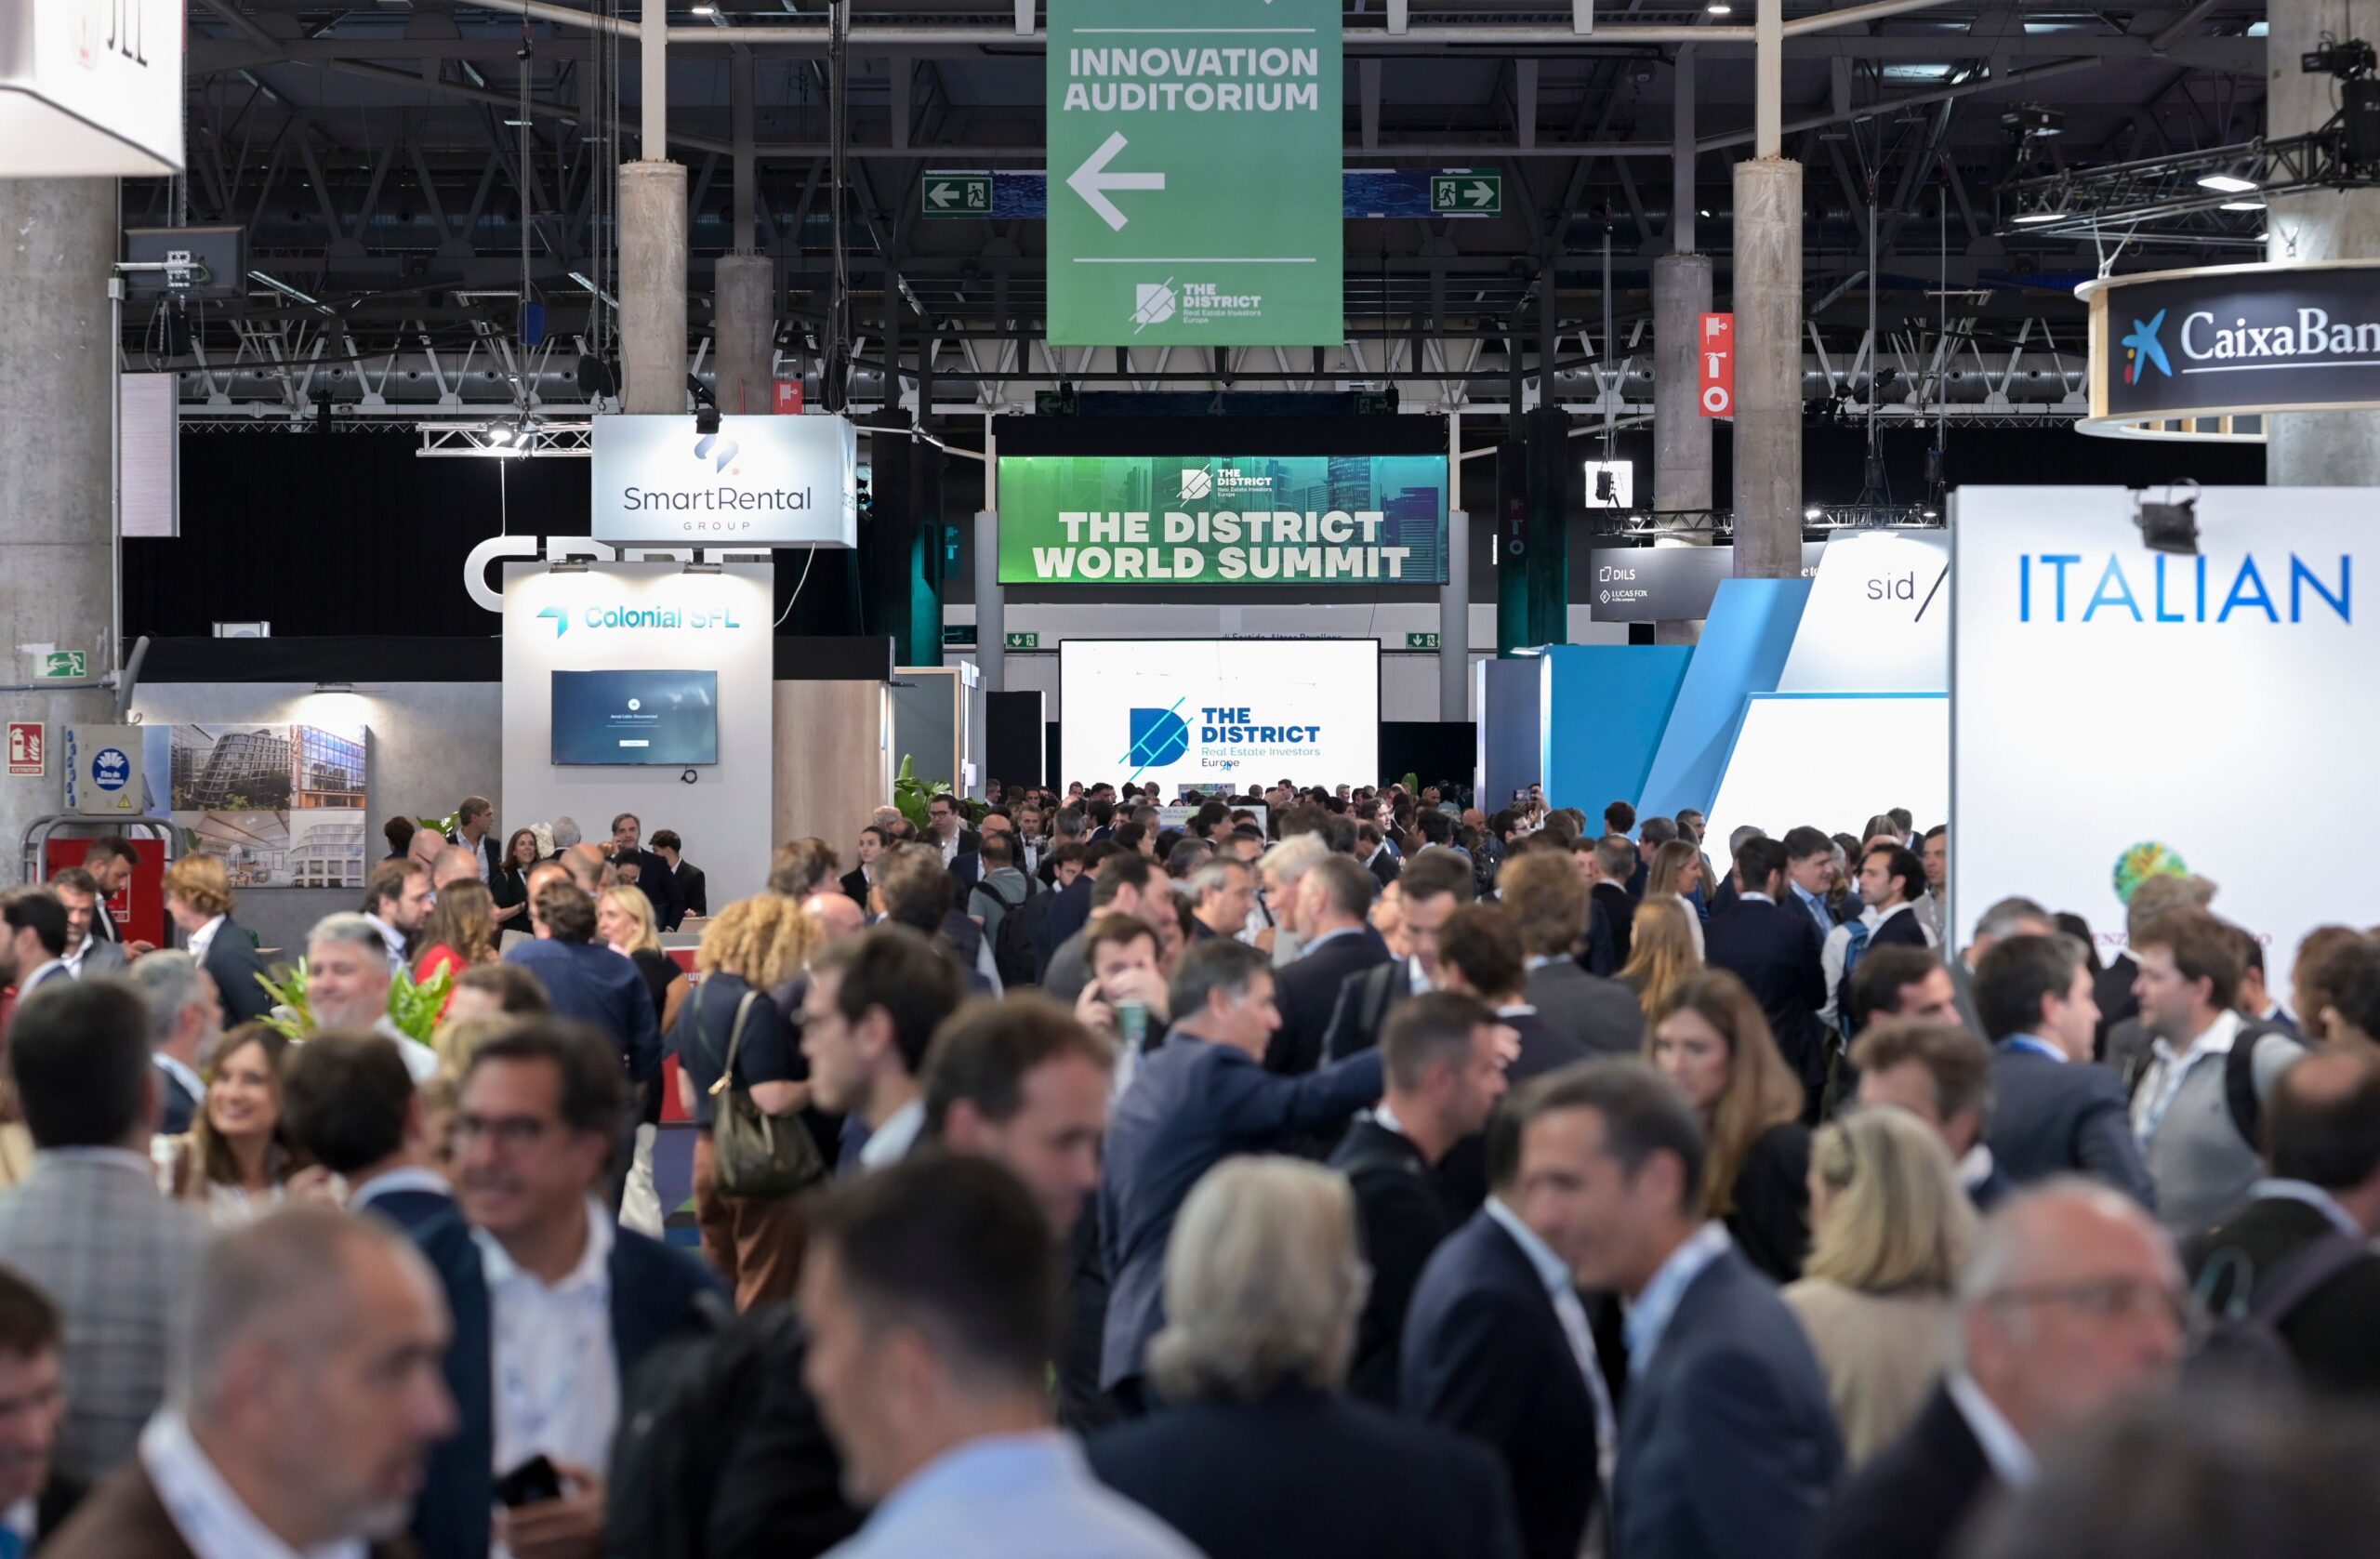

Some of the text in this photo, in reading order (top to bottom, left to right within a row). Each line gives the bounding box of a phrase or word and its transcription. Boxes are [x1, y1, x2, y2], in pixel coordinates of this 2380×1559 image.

[1070, 47, 1318, 77] INNOVATION
[1063, 83, 1318, 112] AUDITORIUM
[1183, 284, 1216, 295] THE
[1183, 296, 1262, 308] DISTRICT
[2180, 307, 2380, 361] CaixaBan
[1217, 469, 1241, 477] THE
[1217, 477, 1273, 486] DISTRICT
[623, 486, 812, 510] SmartRental
[683, 522, 750, 531] GROUP
[1058, 510, 1383, 544] THE DISTRICT
[1032, 547, 1410, 579] WORLD SUMMIT
[1613, 569, 1635, 580] DILS
[2019, 551, 2352, 625] ITALIAN
[585, 605, 740, 628] Colonial SFL
[1201, 707, 1250, 724] THE
[1201, 725, 1320, 743] DISTRICT
[1201, 746, 1320, 756] Real Estate Investors
[1201, 758, 1240, 768] Europe
